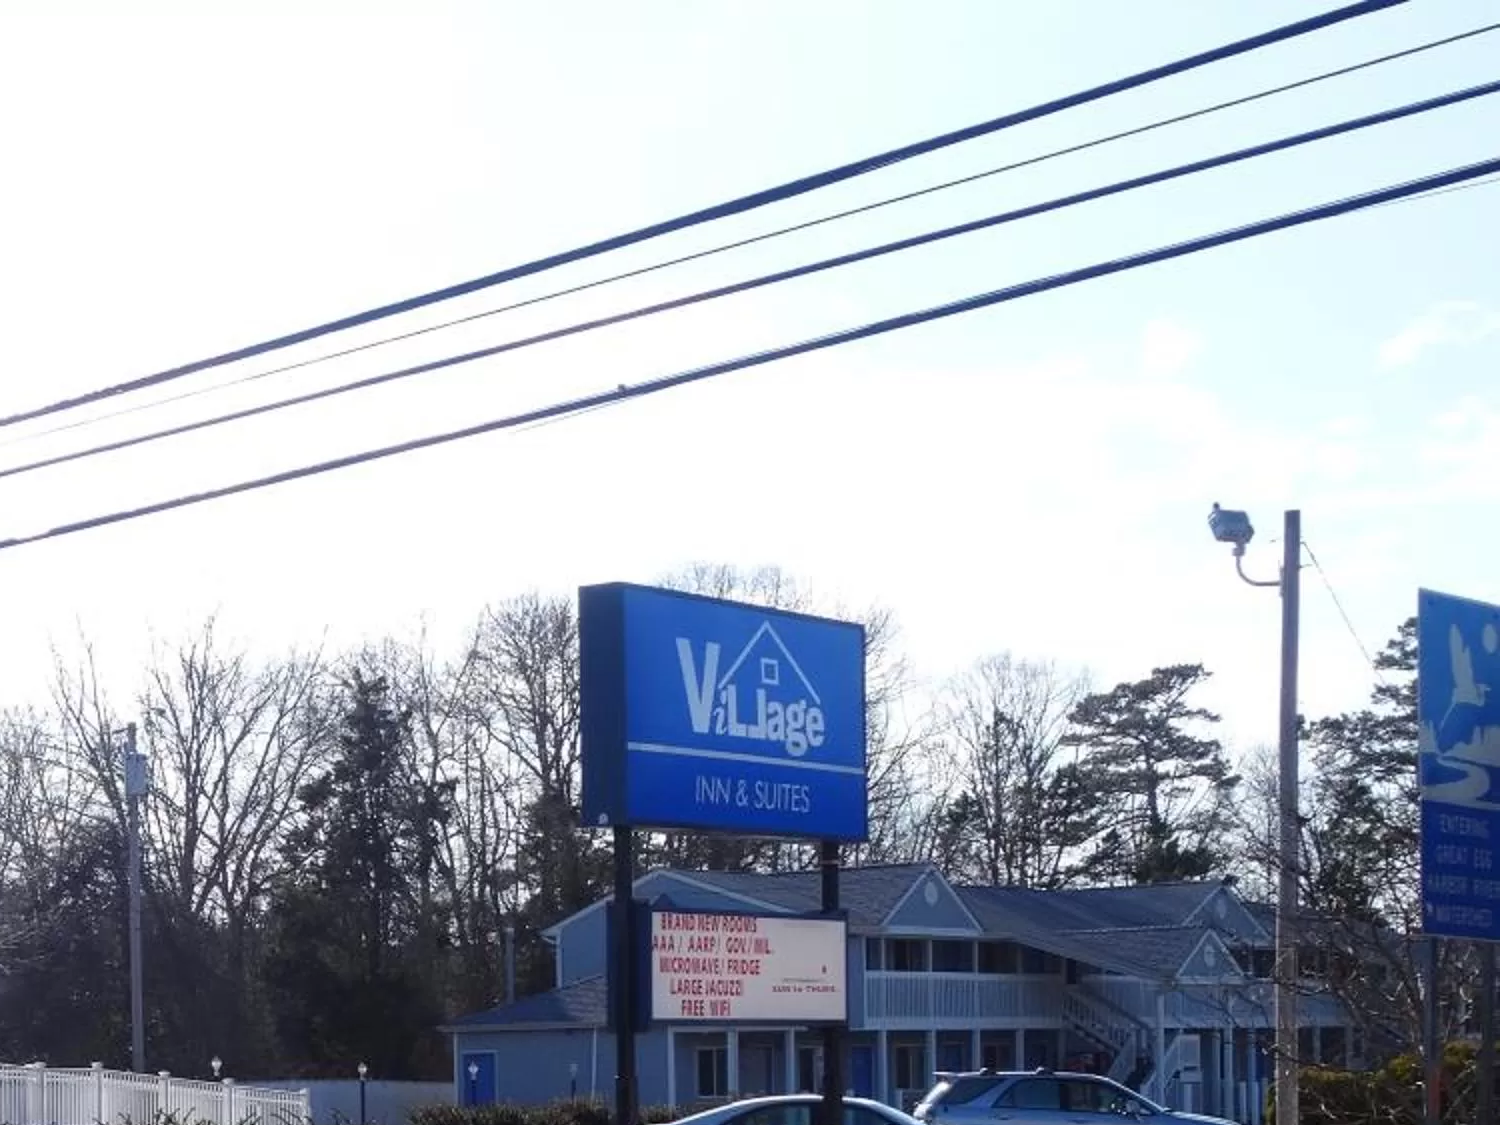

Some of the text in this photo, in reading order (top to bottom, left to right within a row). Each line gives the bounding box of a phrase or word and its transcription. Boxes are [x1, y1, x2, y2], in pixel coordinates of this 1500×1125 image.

[695, 775, 811, 813] INN & SUITES
[660, 913, 757, 933] BRAND NEW ROOMS
[727, 959, 761, 975] FRIDGE
[670, 979, 744, 997] LARGE JACUZZI
[681, 999, 705, 1016] FREE
